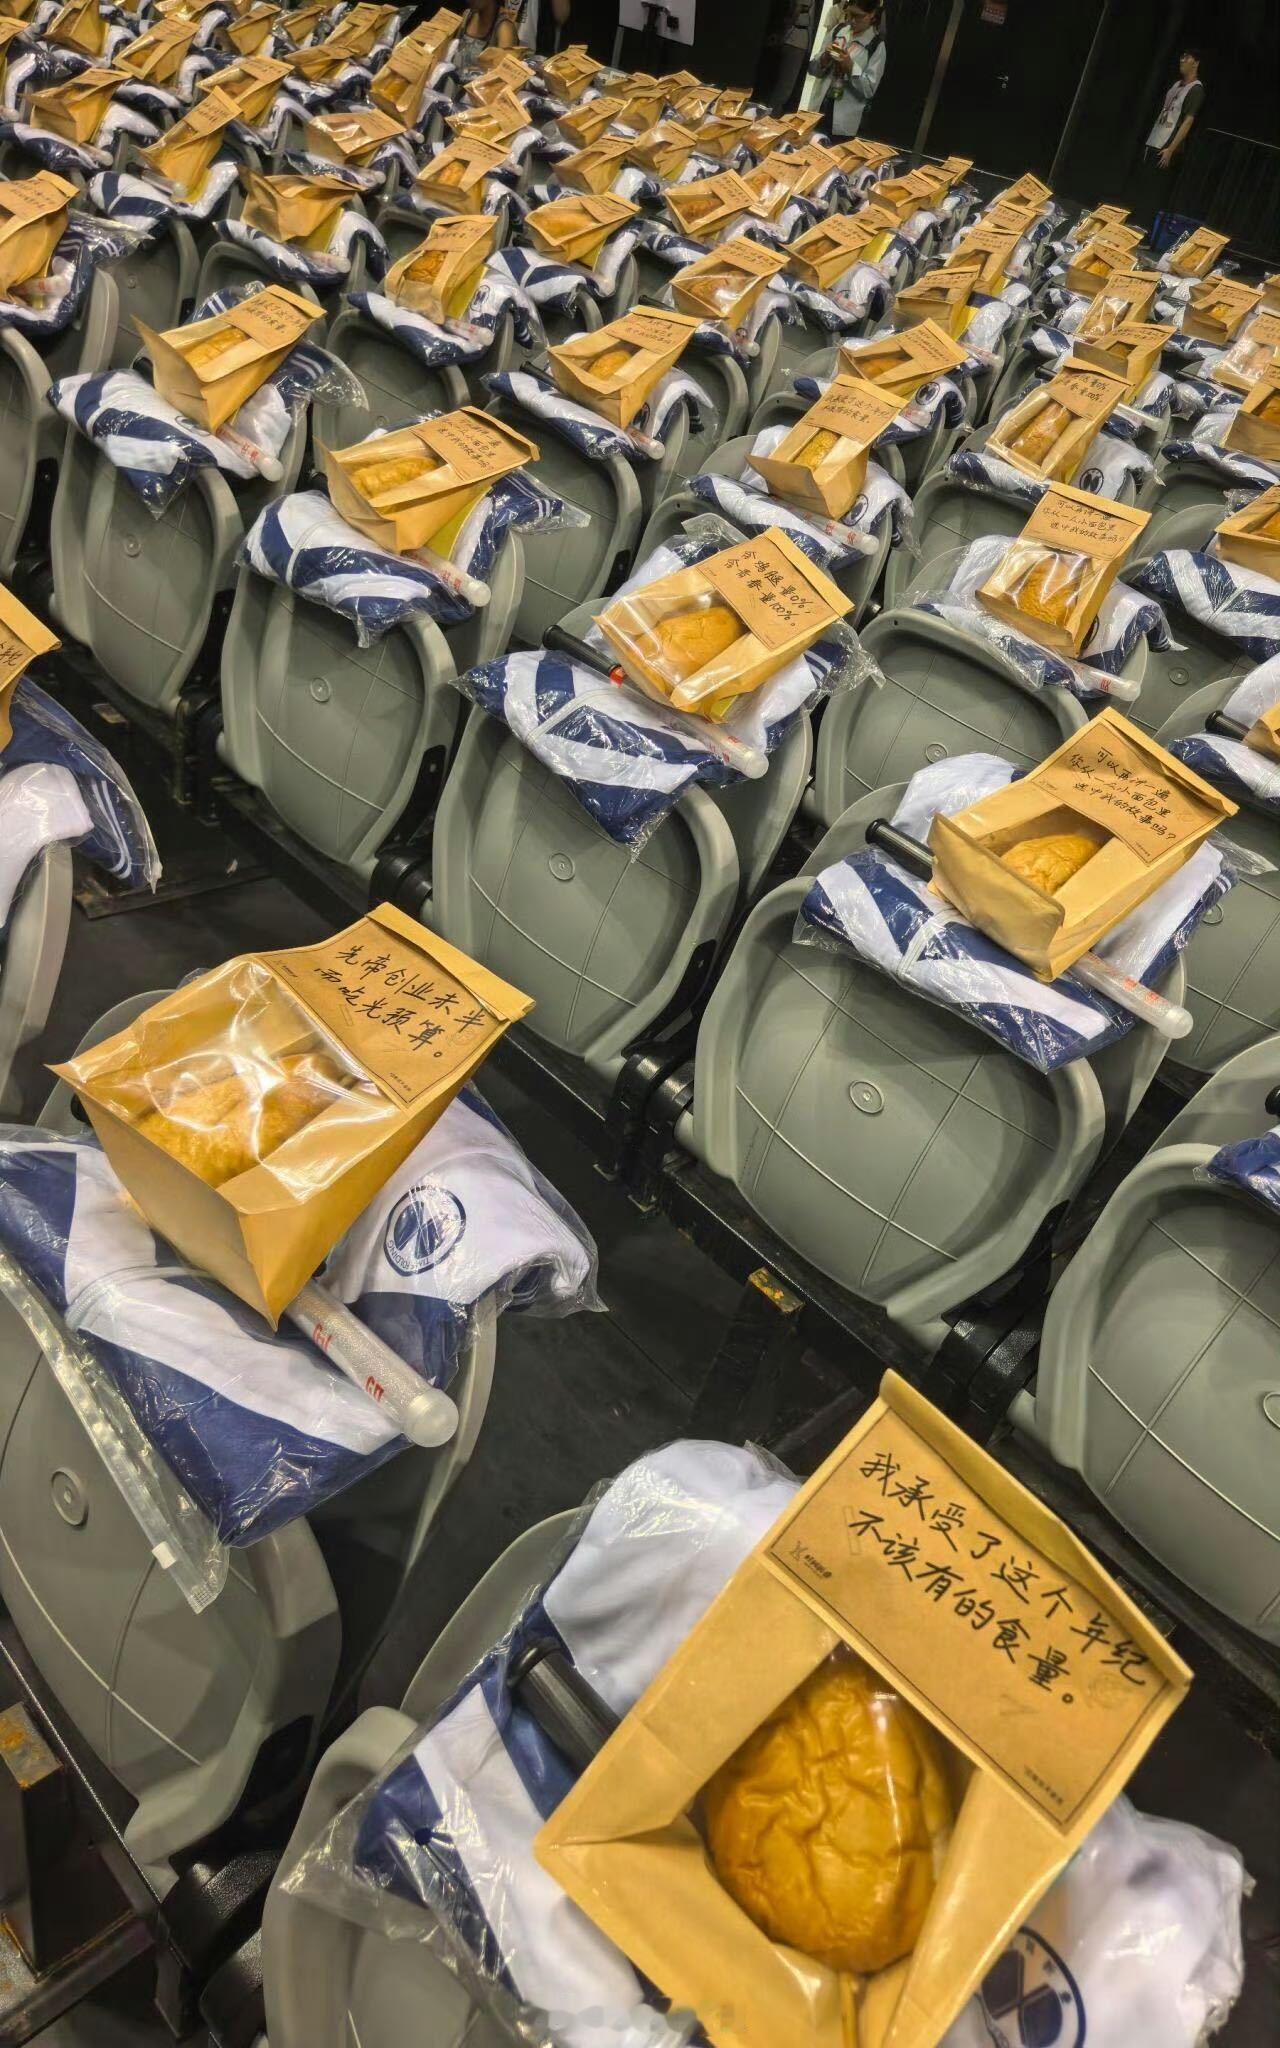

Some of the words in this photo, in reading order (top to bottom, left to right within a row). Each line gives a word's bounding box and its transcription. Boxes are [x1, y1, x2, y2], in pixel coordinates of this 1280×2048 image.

[314, 967, 443, 1059] 而吃光预算。
[335, 944, 485, 1034] 先帝创业未半
[848, 1509, 1075, 1705] 不该有的食量。
[859, 1452, 1151, 1687] 我承受了这个年纪
